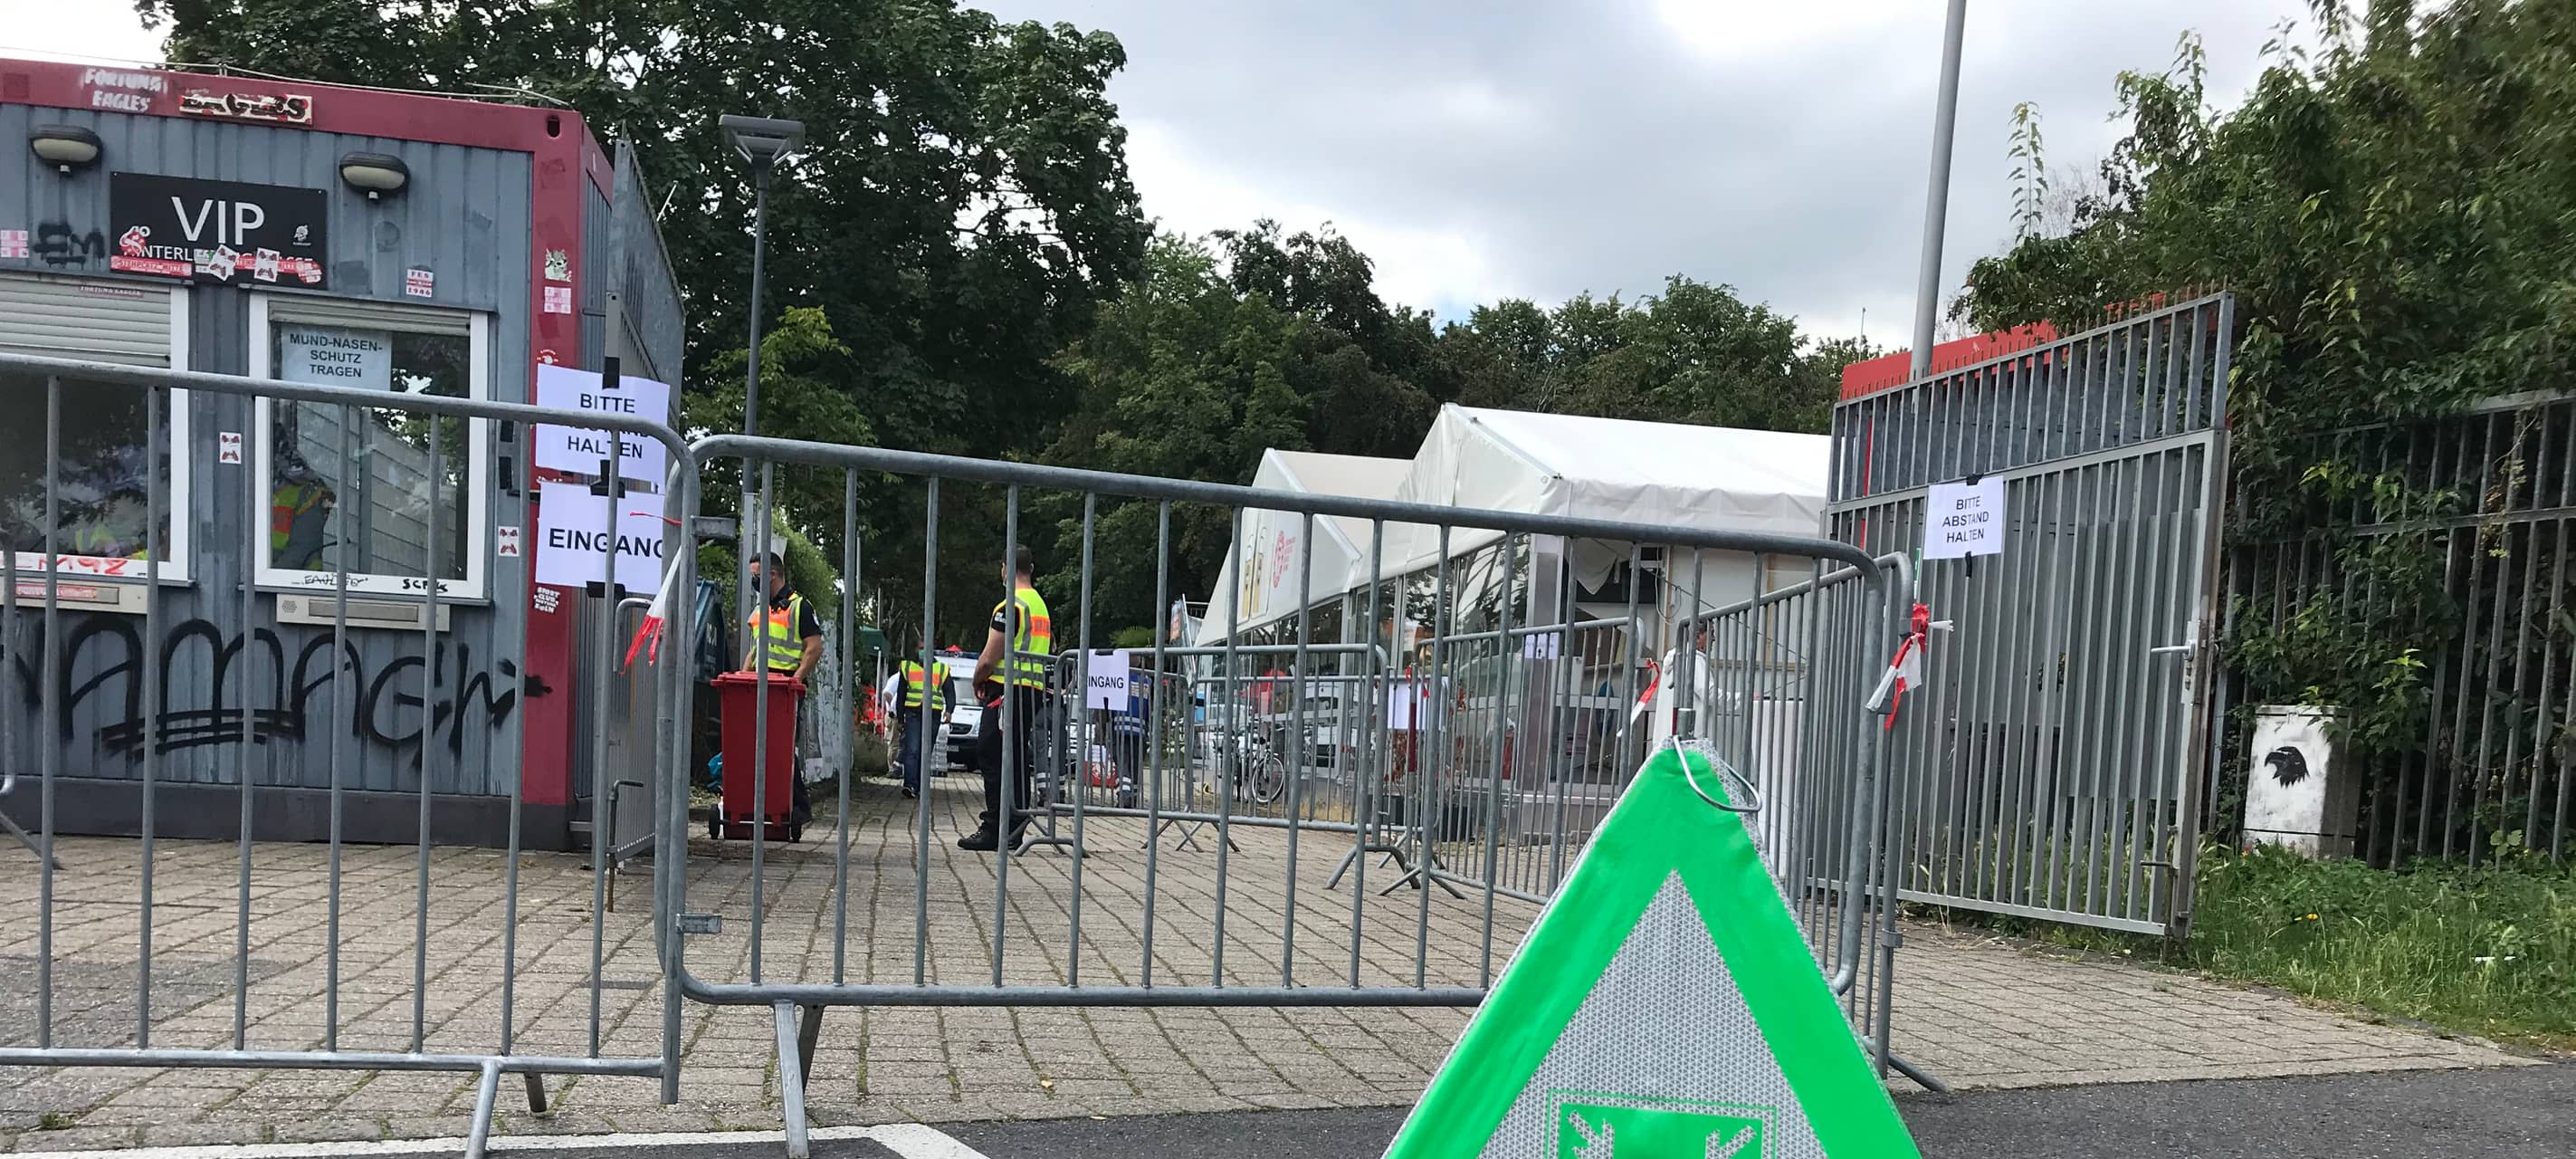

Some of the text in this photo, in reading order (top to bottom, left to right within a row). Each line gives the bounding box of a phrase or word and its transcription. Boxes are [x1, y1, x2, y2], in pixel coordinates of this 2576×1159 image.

[92, 90, 150, 113] EAGLES
[171, 195, 265, 245] VIP
[290, 333, 382, 351] MUND-NASEN-
[310, 350, 361, 363] SCHUTZ
[310, 364, 361, 378] TRAGEN
[580, 393, 635, 414] BITTE
[1956, 495, 1980, 510] BITTE
[1942, 511, 1989, 527] ABSTAND
[1947, 528, 1984, 543] HALTEN
[1088, 675, 1124, 688] INGANG
